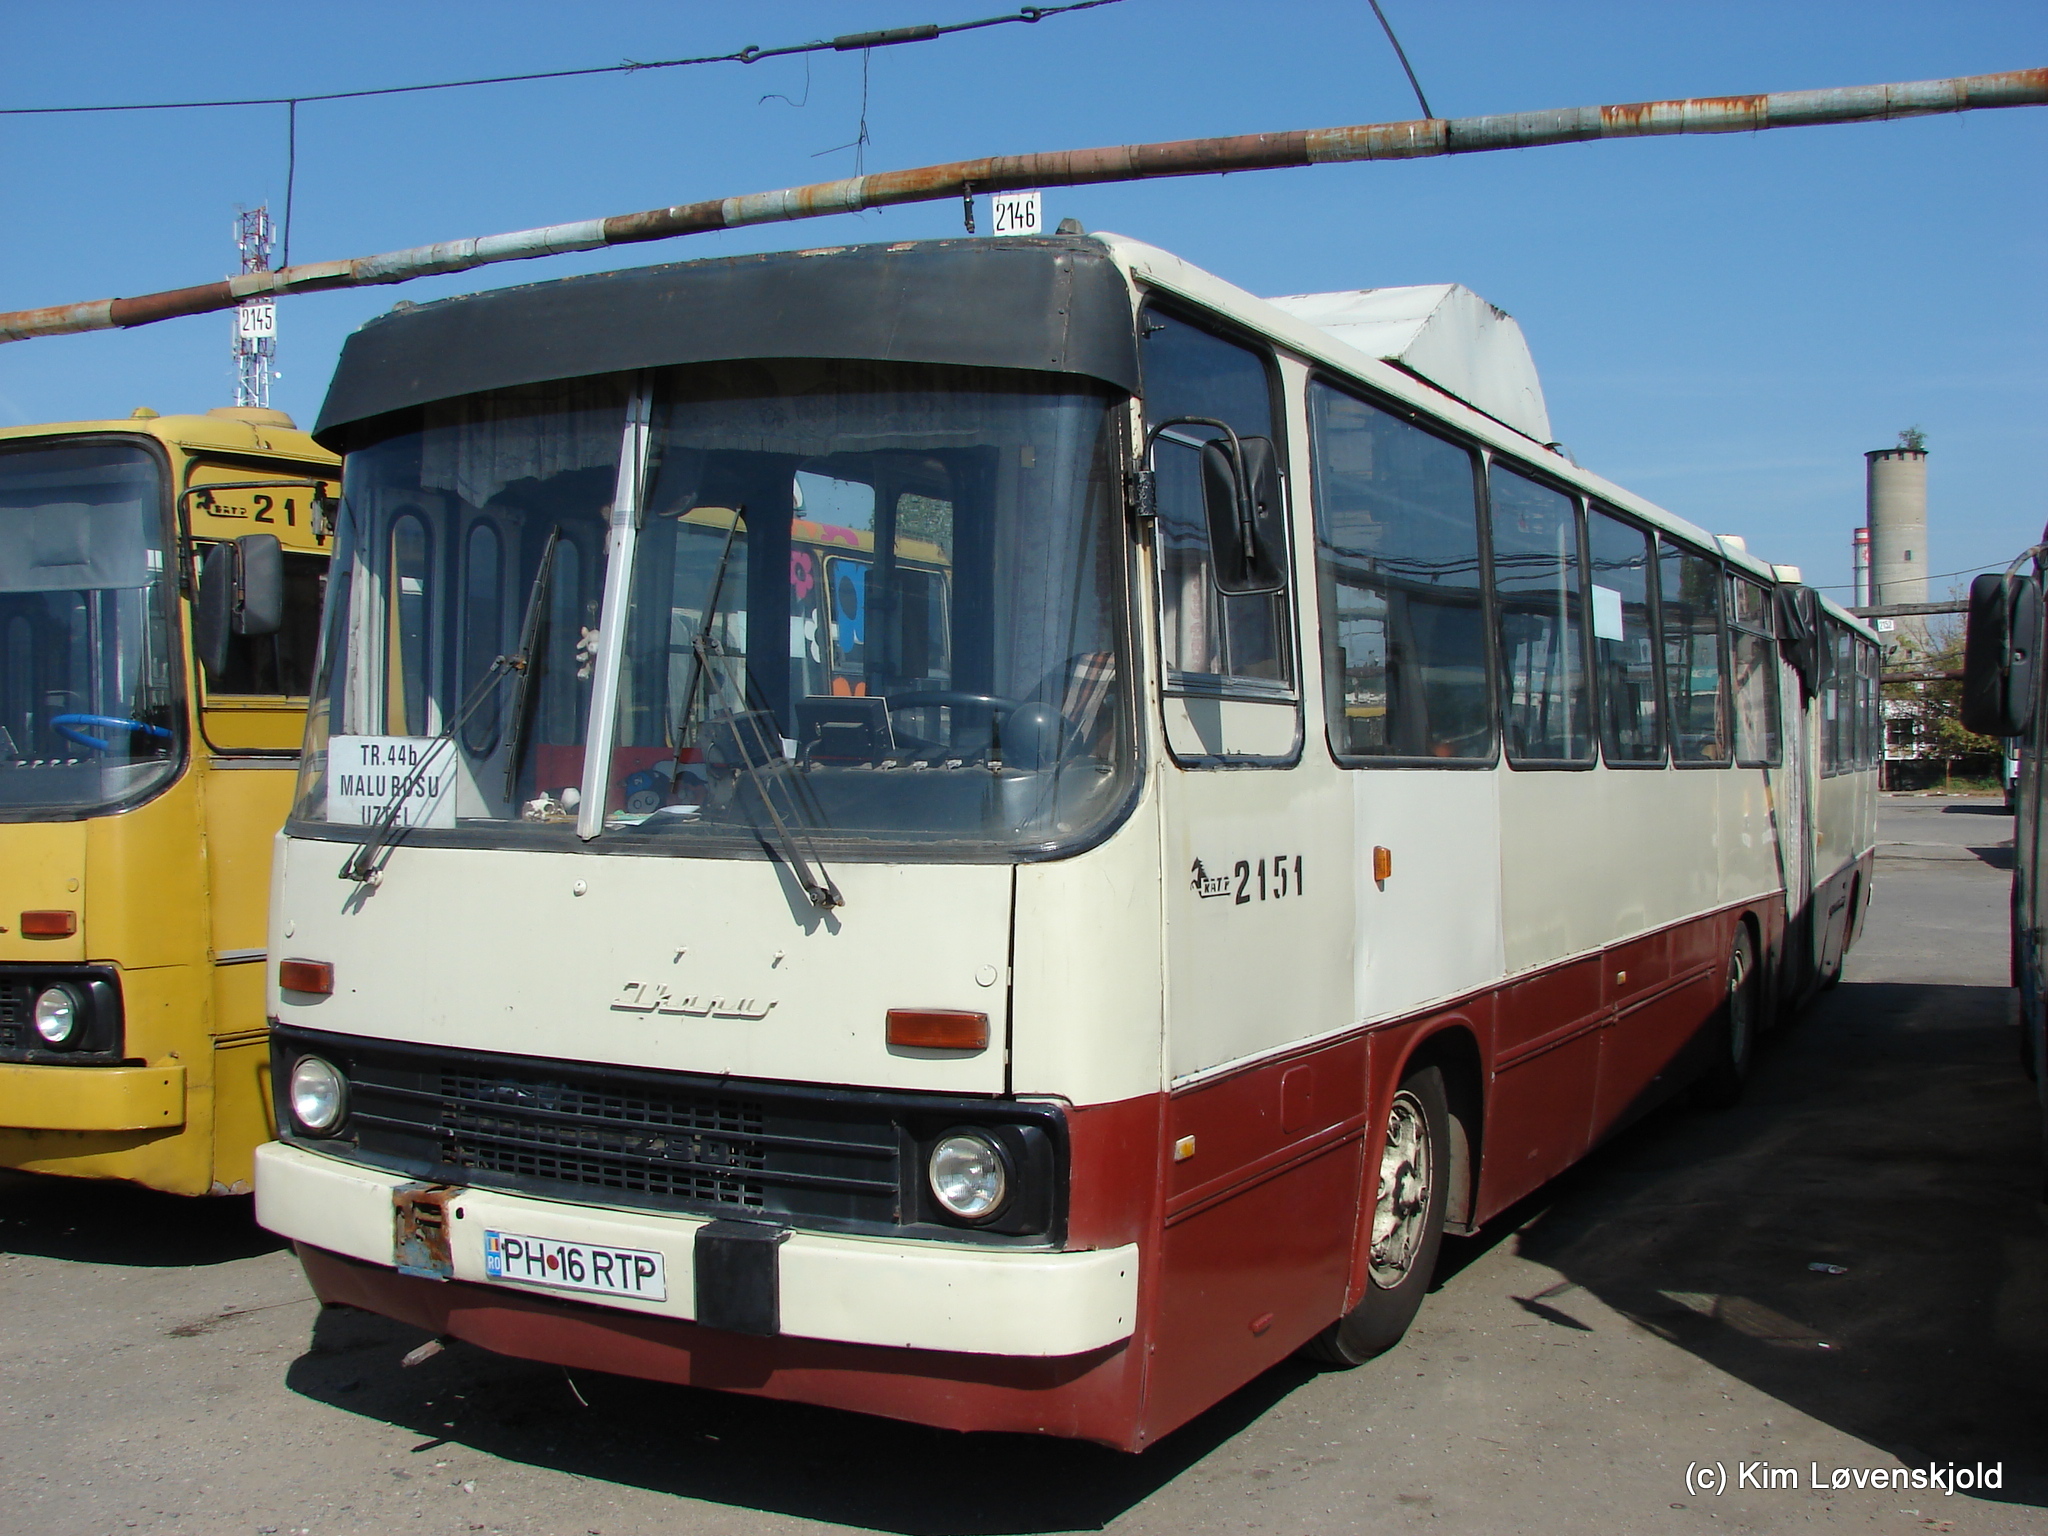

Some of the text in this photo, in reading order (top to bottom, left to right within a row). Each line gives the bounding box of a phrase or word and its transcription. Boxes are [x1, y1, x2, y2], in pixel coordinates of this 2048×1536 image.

[996, 200, 1035, 232] 2146
[242, 307, 272, 331] 2145
[361, 744, 418, 766] TR.44b
[340, 775, 440, 798] MALU ROSU
[1234, 855, 1303, 906] 2151
[487, 1238, 656, 1291] RO PH 16 RTP
